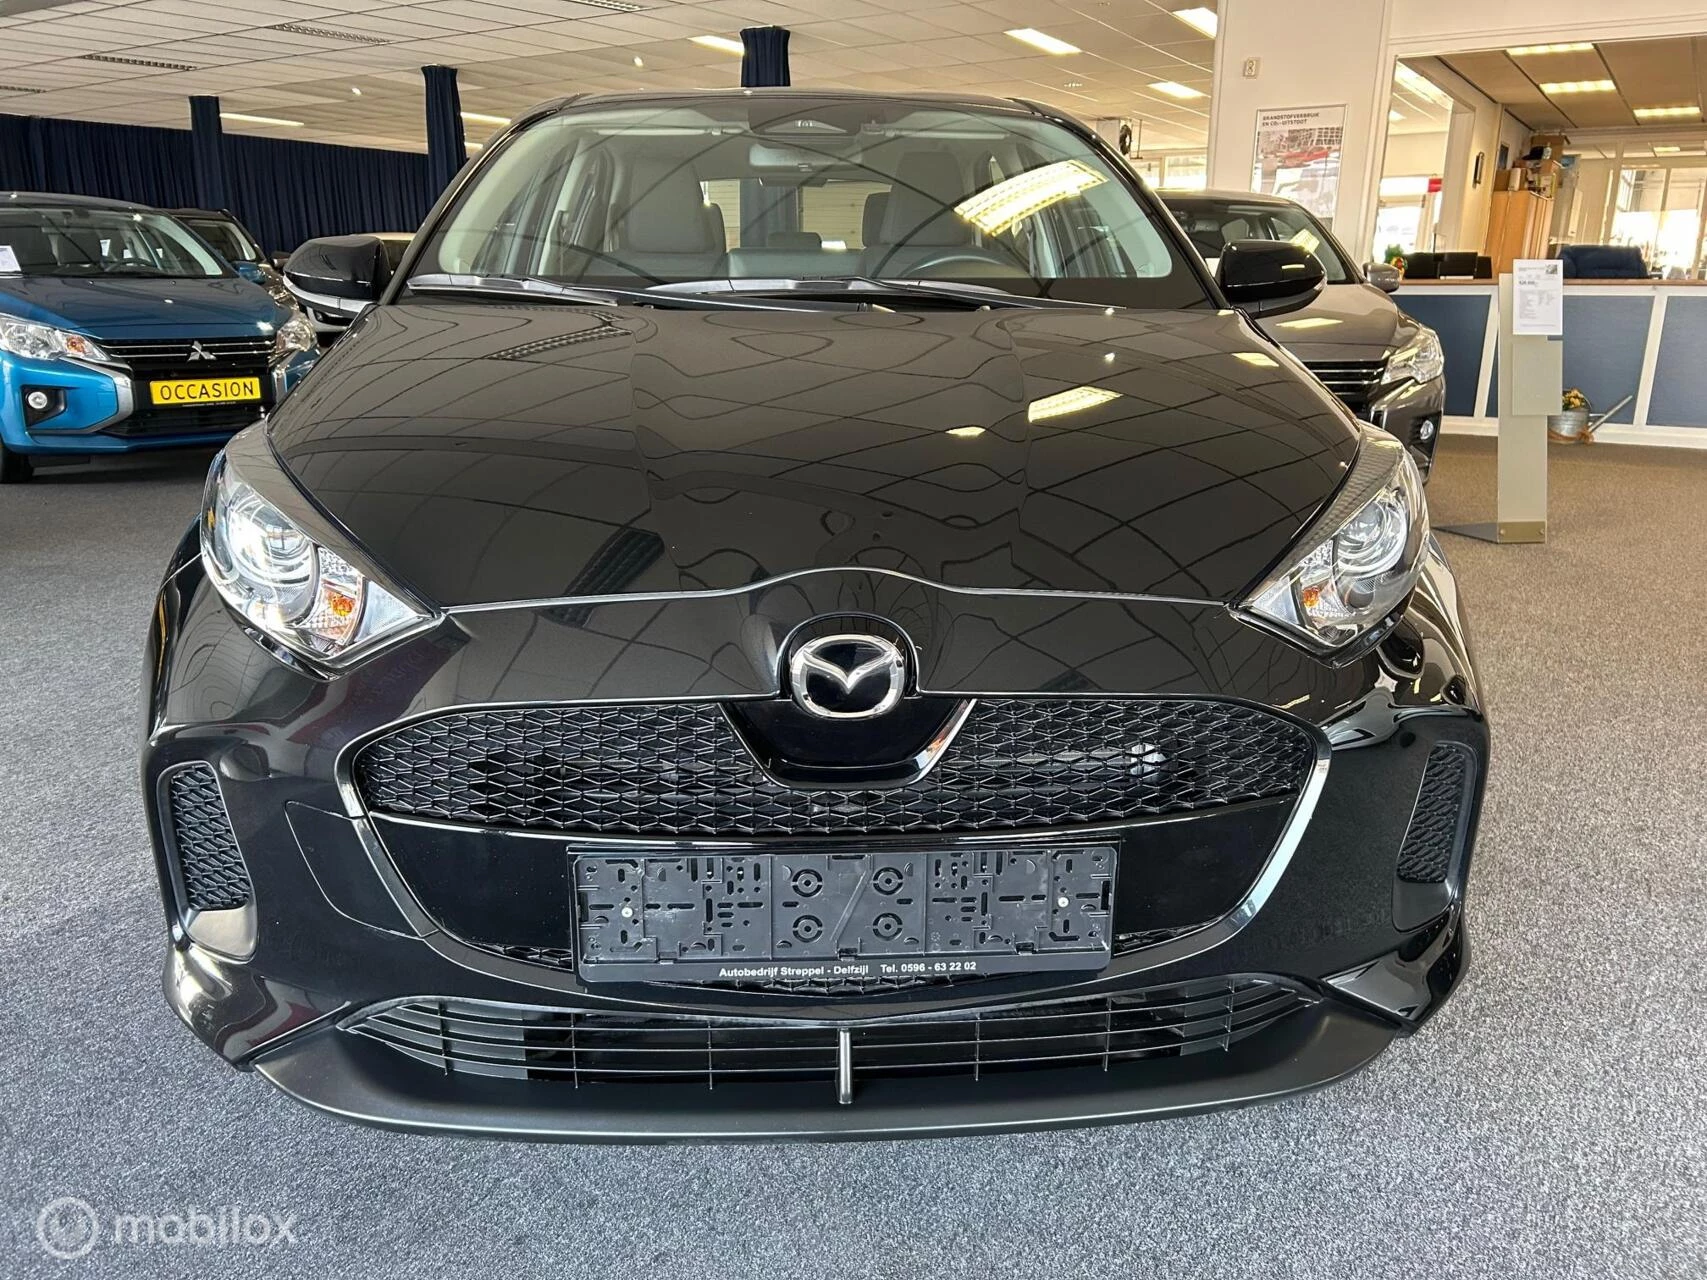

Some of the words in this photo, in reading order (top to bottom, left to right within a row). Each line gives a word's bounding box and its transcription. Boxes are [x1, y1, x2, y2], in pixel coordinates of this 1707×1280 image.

[160, 382, 253, 400] OCCASION
[719, 967, 779, 978] Autobedrijf
[780, 965, 825, 977] Streppel
[833, 964, 869, 976] Delfzijl
[880, 963, 899, 973] Tel.
[900, 963, 926, 972] 0596
[934, 962, 948, 971] 63
[949, 962, 962, 971] 22
[964, 961, 977, 970] 02
